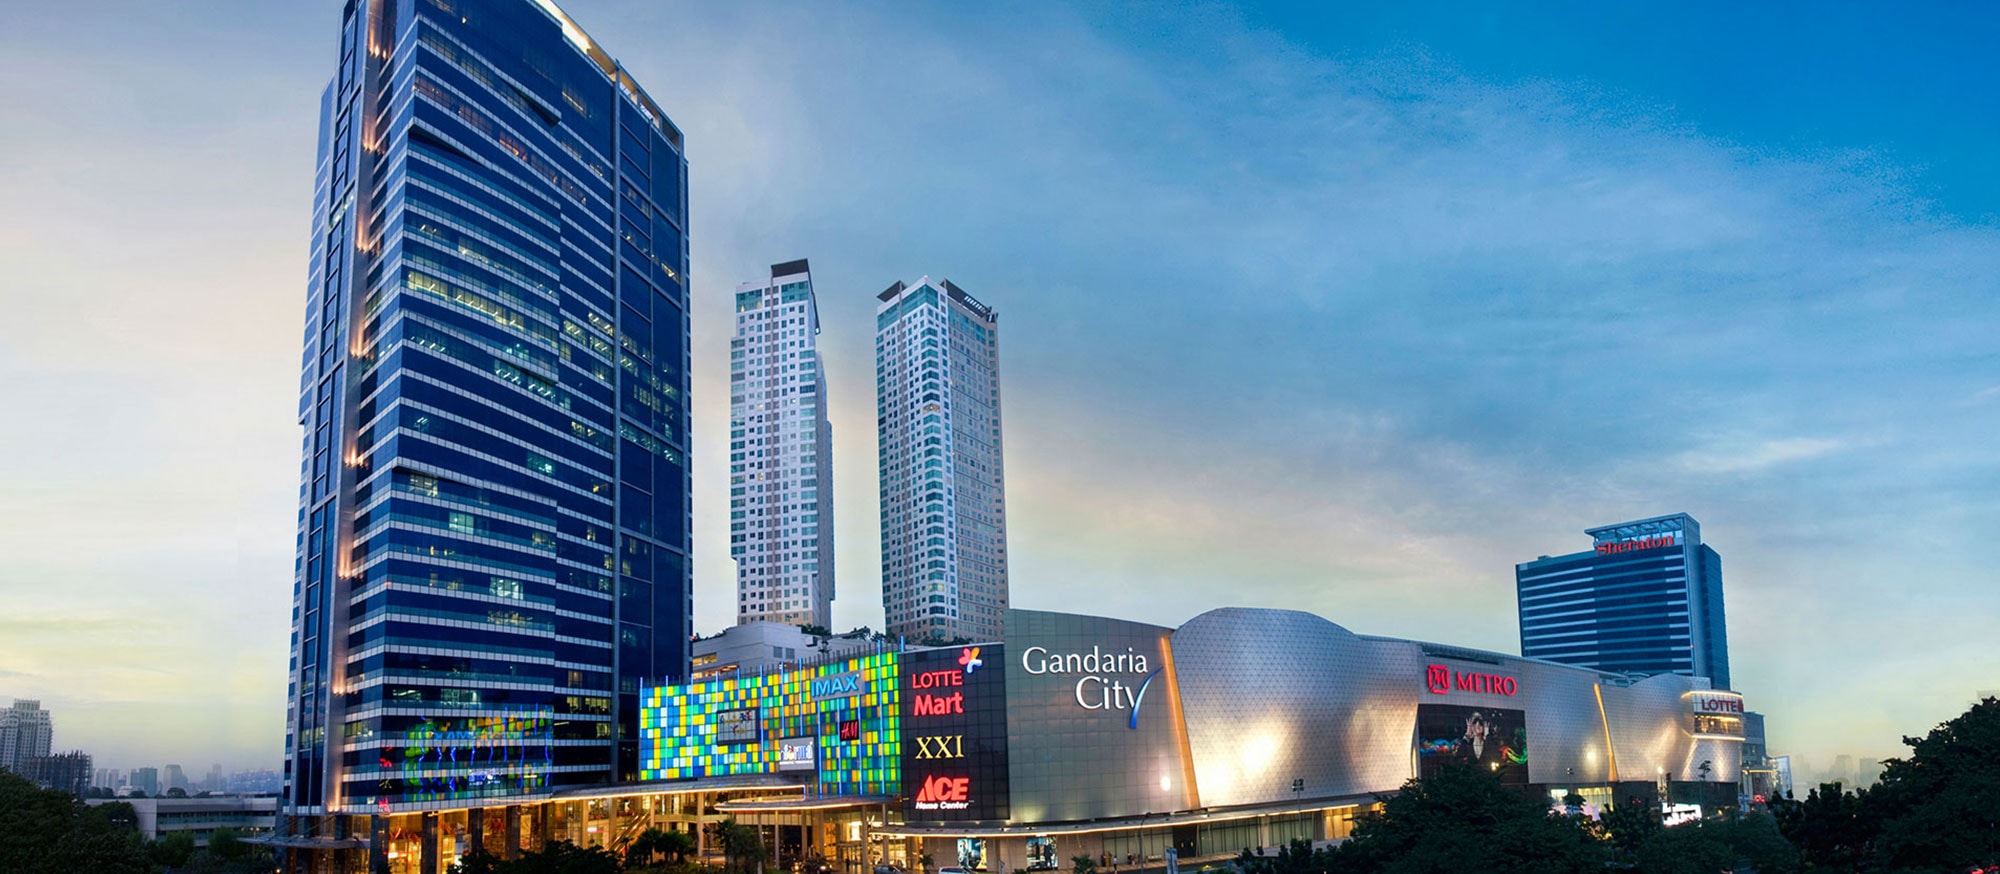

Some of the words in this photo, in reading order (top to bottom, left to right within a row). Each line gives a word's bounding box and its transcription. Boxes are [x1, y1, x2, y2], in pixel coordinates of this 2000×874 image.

[1596, 535, 1674, 556] Sheraton
[1022, 645, 1148, 675] Gandaria
[811, 674, 859, 697] IMAX
[912, 669, 964, 689] LOTTE
[1456, 671, 1518, 697] METRO
[913, 691, 965, 717] Mart
[1075, 668, 1164, 729] City
[1701, 698, 1737, 712] LOTTE
[841, 721, 858, 740] H&M
[915, 735, 965, 760] XXI
[916, 774, 970, 801] ACE
[915, 801, 938, 810] Home
[940, 801, 969, 810] Center
